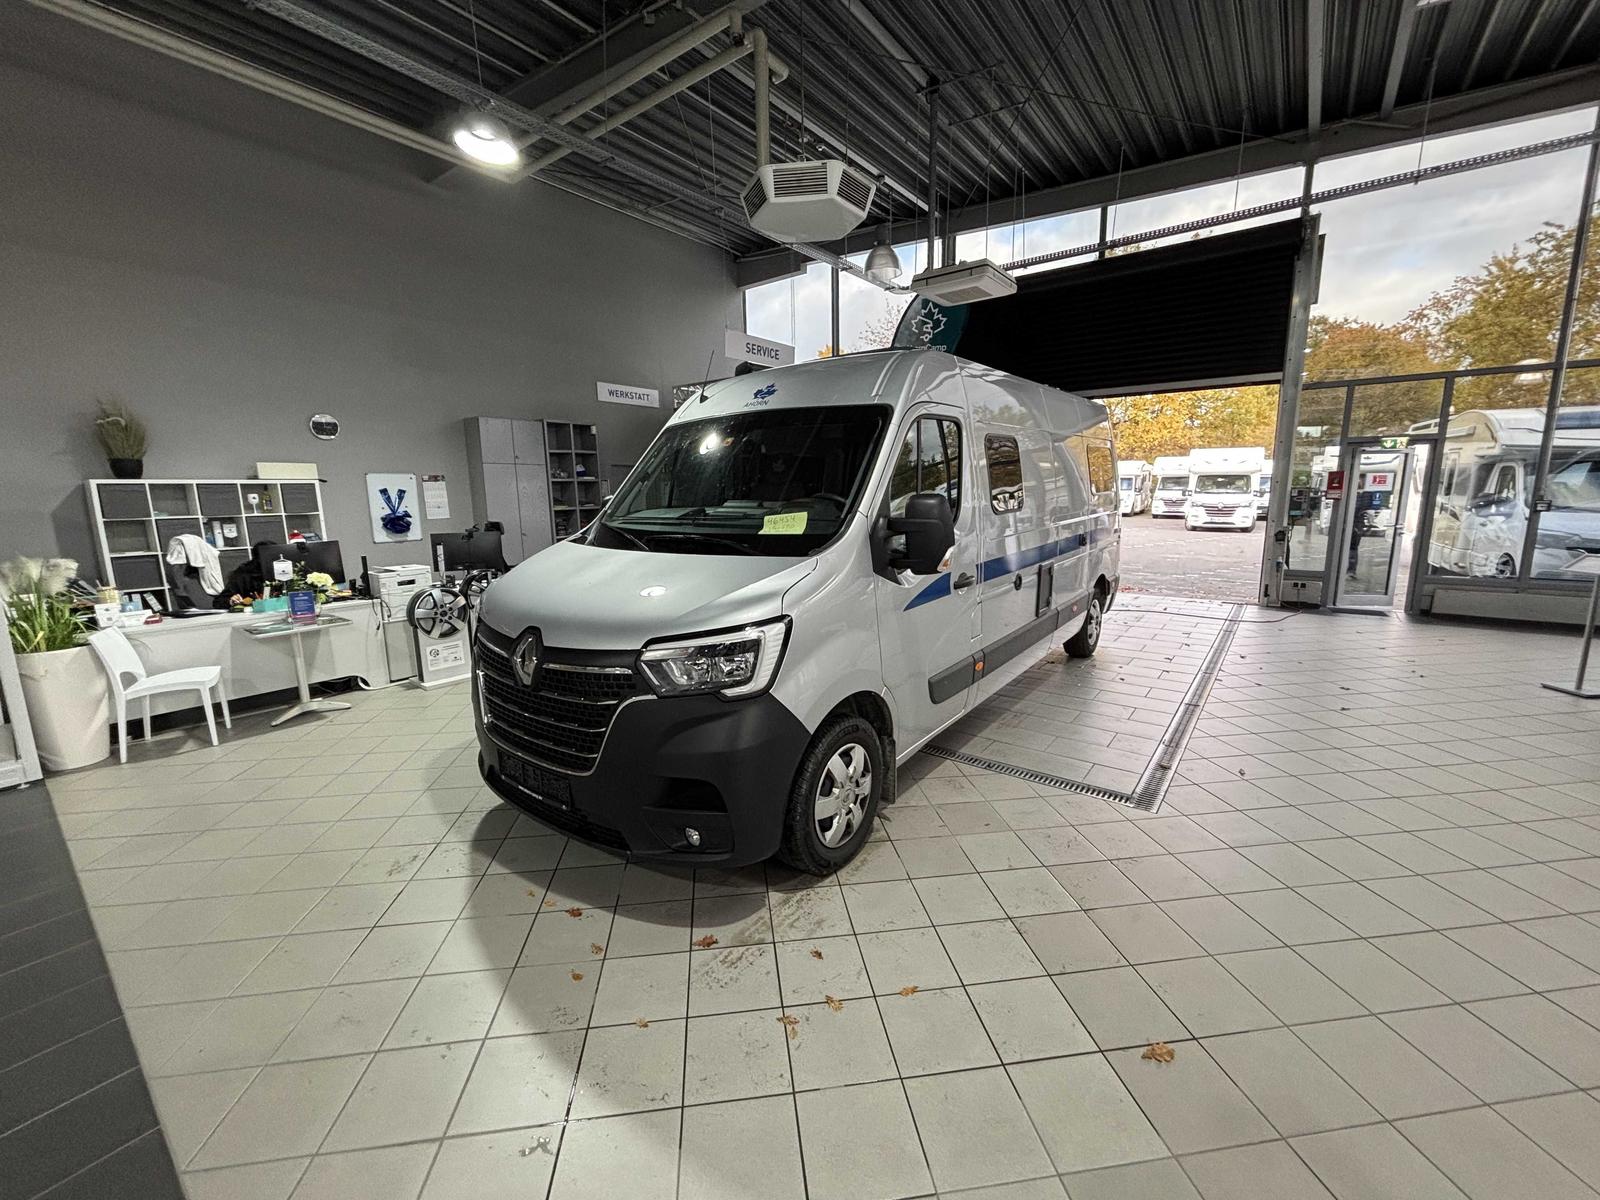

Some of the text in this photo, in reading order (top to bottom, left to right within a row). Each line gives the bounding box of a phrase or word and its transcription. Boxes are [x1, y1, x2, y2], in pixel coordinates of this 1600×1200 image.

[745, 342, 780, 361] SERVICE
[607, 388, 650, 402] WERKSTATT
[743, 399, 770, 408] AHORN
